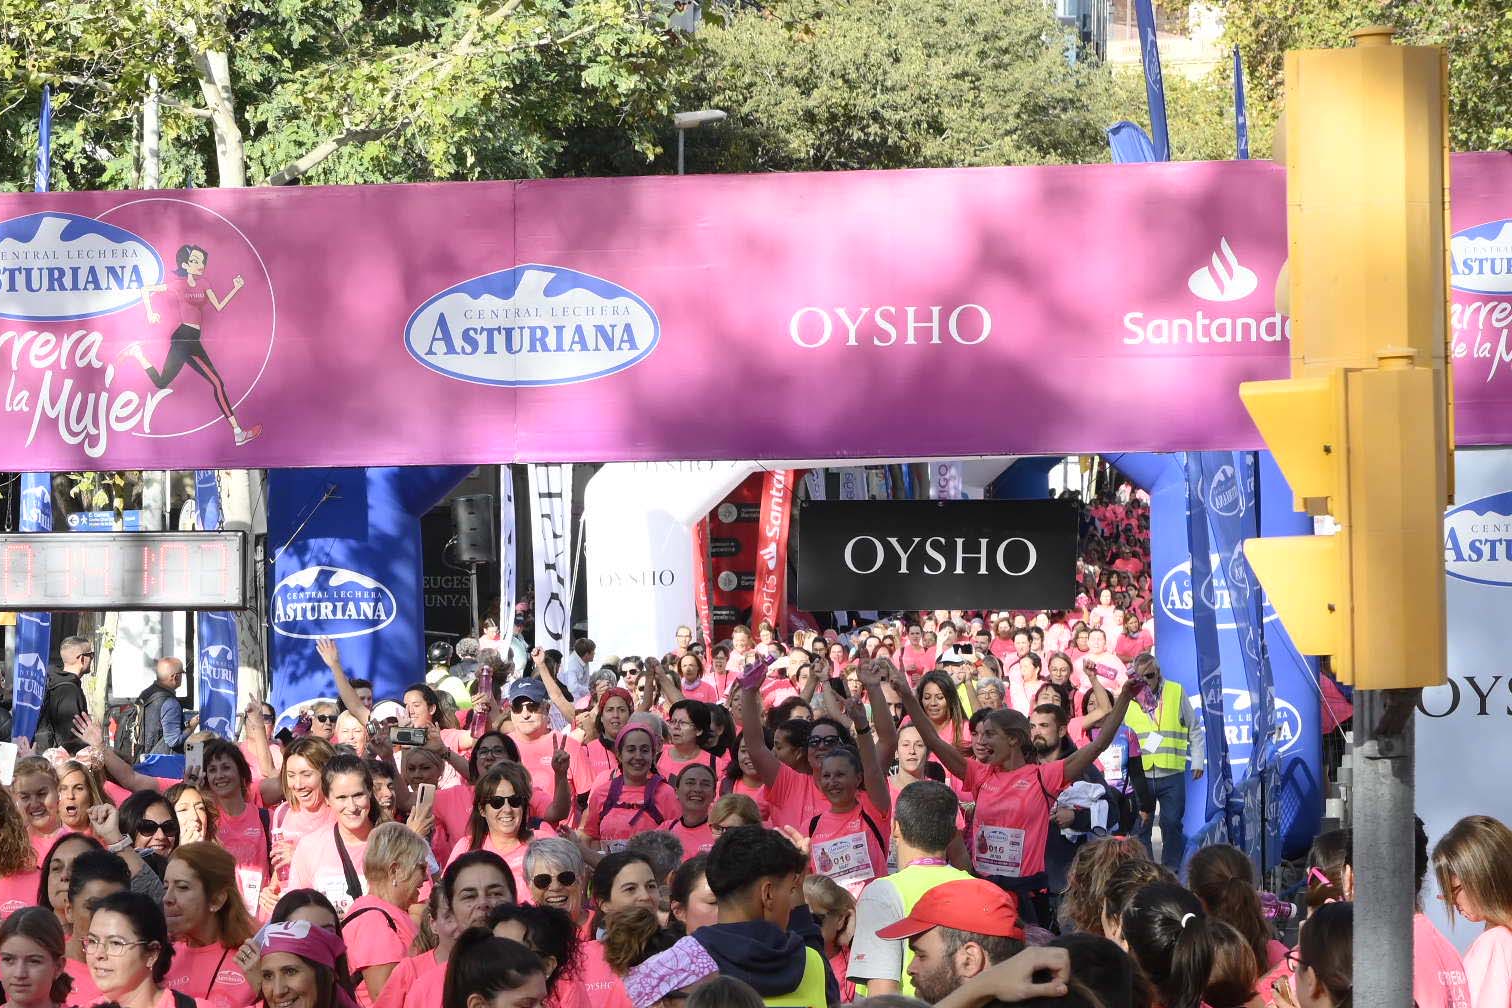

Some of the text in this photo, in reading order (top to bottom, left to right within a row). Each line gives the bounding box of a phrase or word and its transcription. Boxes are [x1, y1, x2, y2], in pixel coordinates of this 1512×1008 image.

[67, 249, 139, 260] LECHERA
[464, 304, 630, 319] CENTRAL LECHERA
[789, 303, 991, 350] OYSHO
[425, 311, 640, 356] ASTURIANA
[5, 372, 30, 412] la
[25, 364, 174, 458] Mujer
[844, 536, 1037, 576] OYSHO
[275, 596, 387, 623] ASTURIANA
[287, 590, 382, 599] CENTRAL LECHERA
